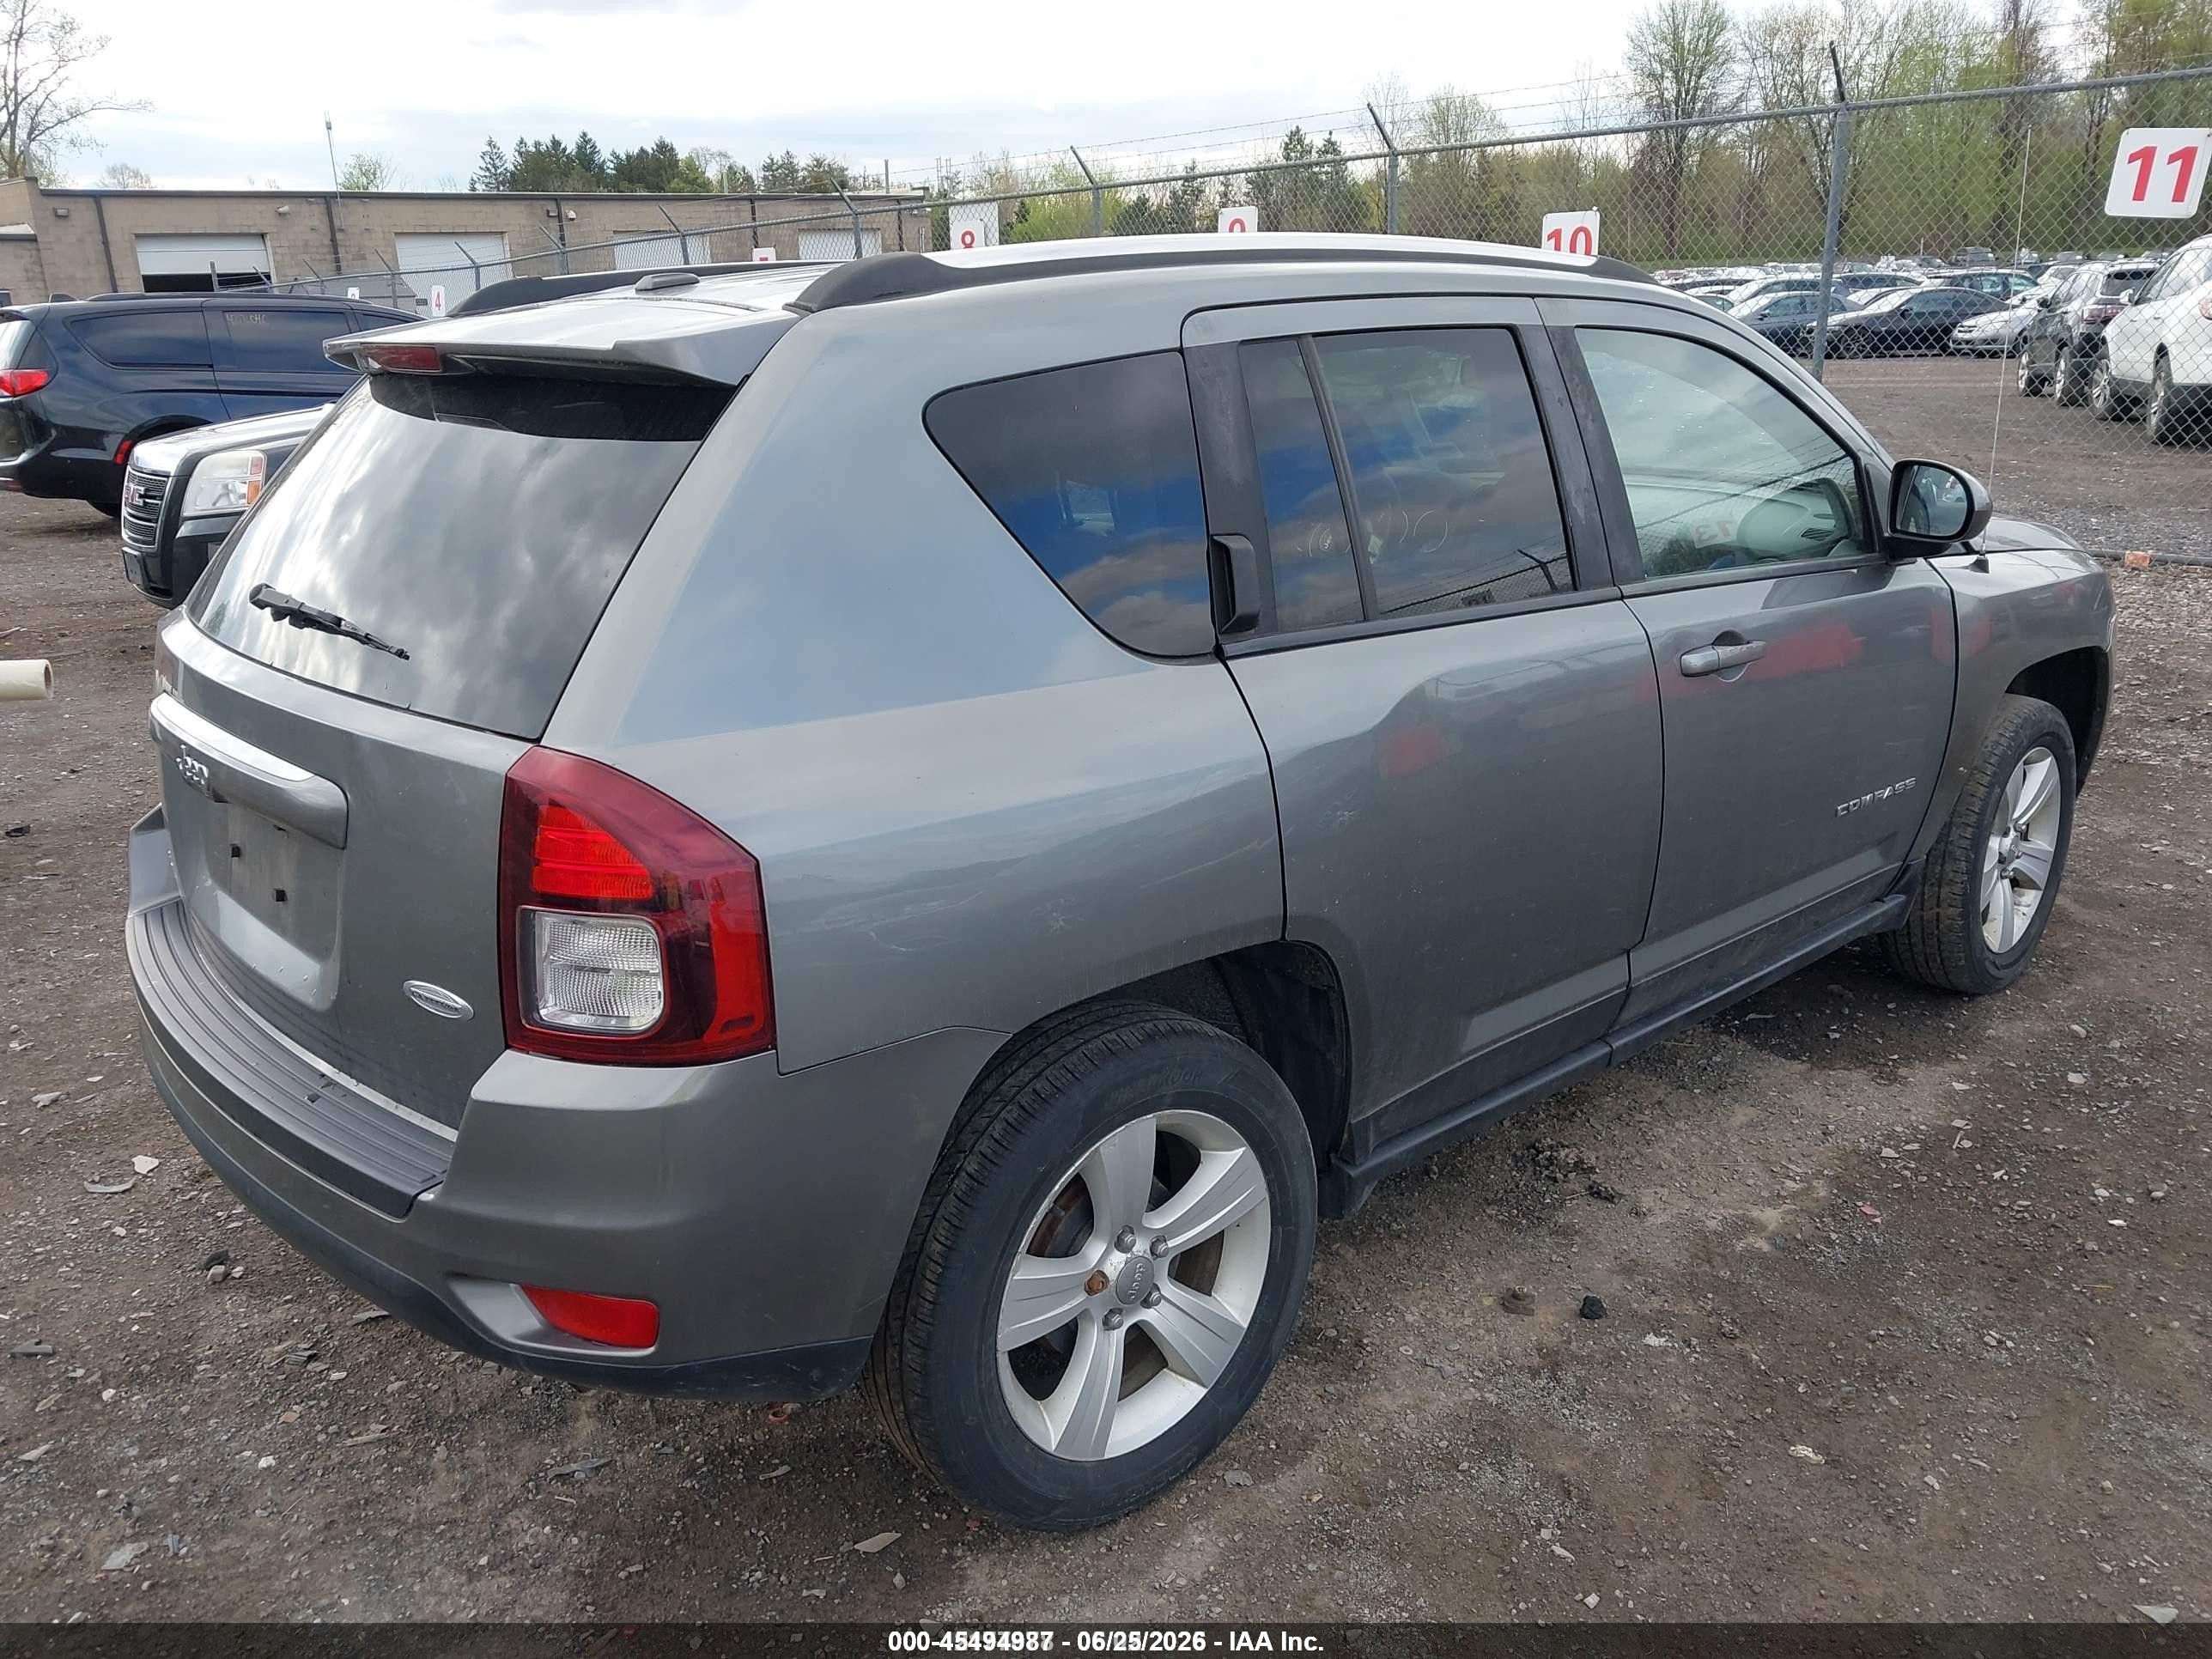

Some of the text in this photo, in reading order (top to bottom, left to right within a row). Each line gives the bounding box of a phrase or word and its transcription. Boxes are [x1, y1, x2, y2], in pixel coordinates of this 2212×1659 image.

[2127, 146, 2198, 202] 11
[1547, 226, 1592, 255] 10
[435, 291, 441, 311] 4
[1836, 777, 1917, 817] COMPASS
[1127, 1262, 1146, 1299] Jeep
